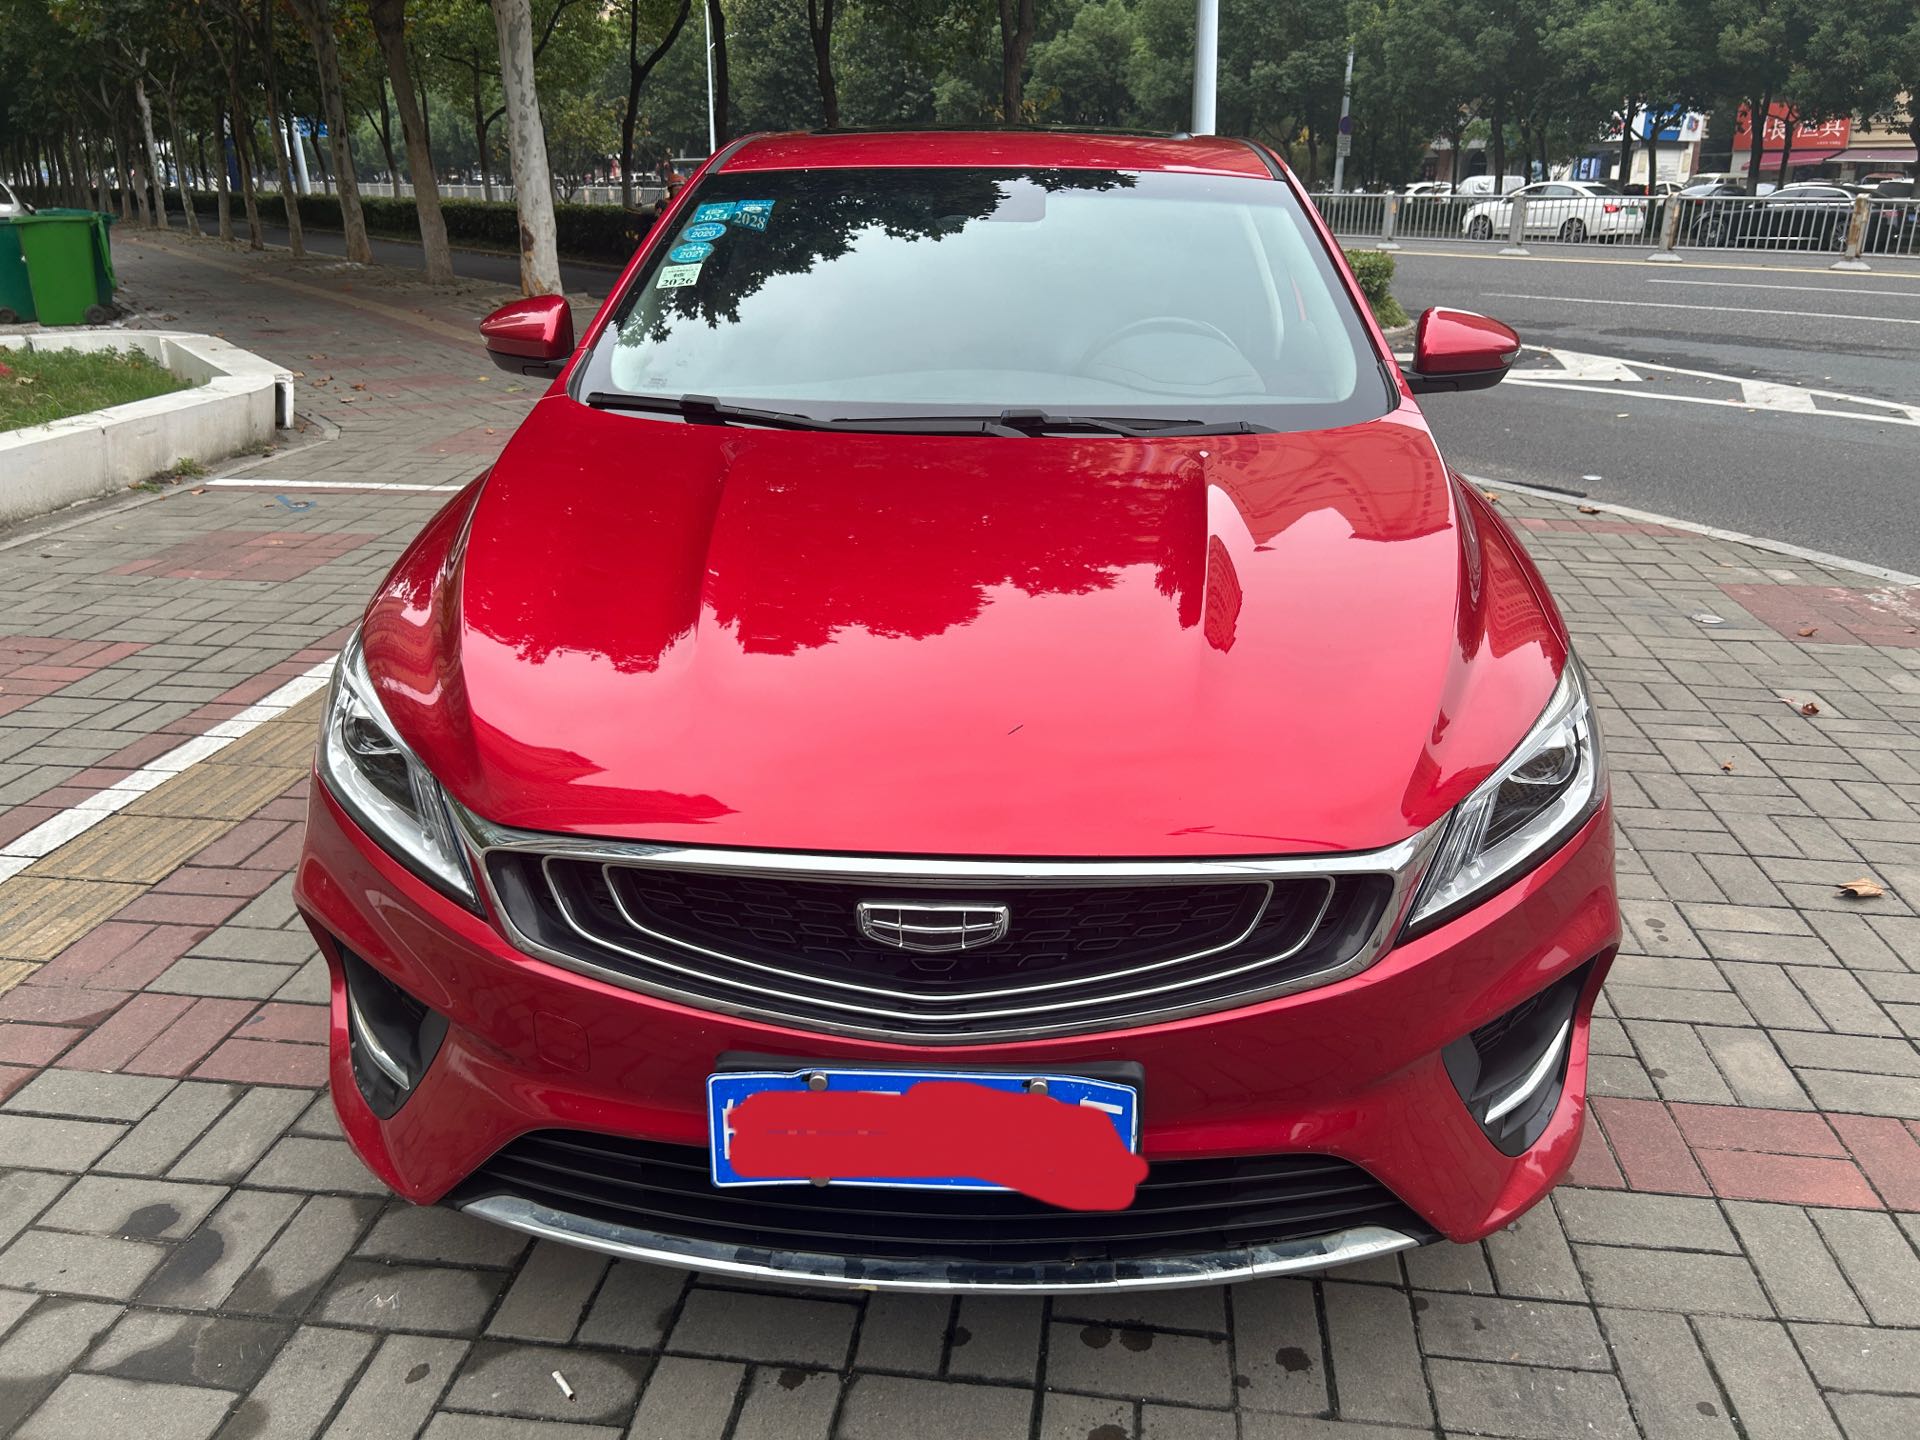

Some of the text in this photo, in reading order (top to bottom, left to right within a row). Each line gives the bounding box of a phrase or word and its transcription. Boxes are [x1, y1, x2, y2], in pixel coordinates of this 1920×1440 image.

[734, 212, 766, 229] 2028
[690, 230, 716, 238] 2020
[661, 278, 693, 287] 2026
